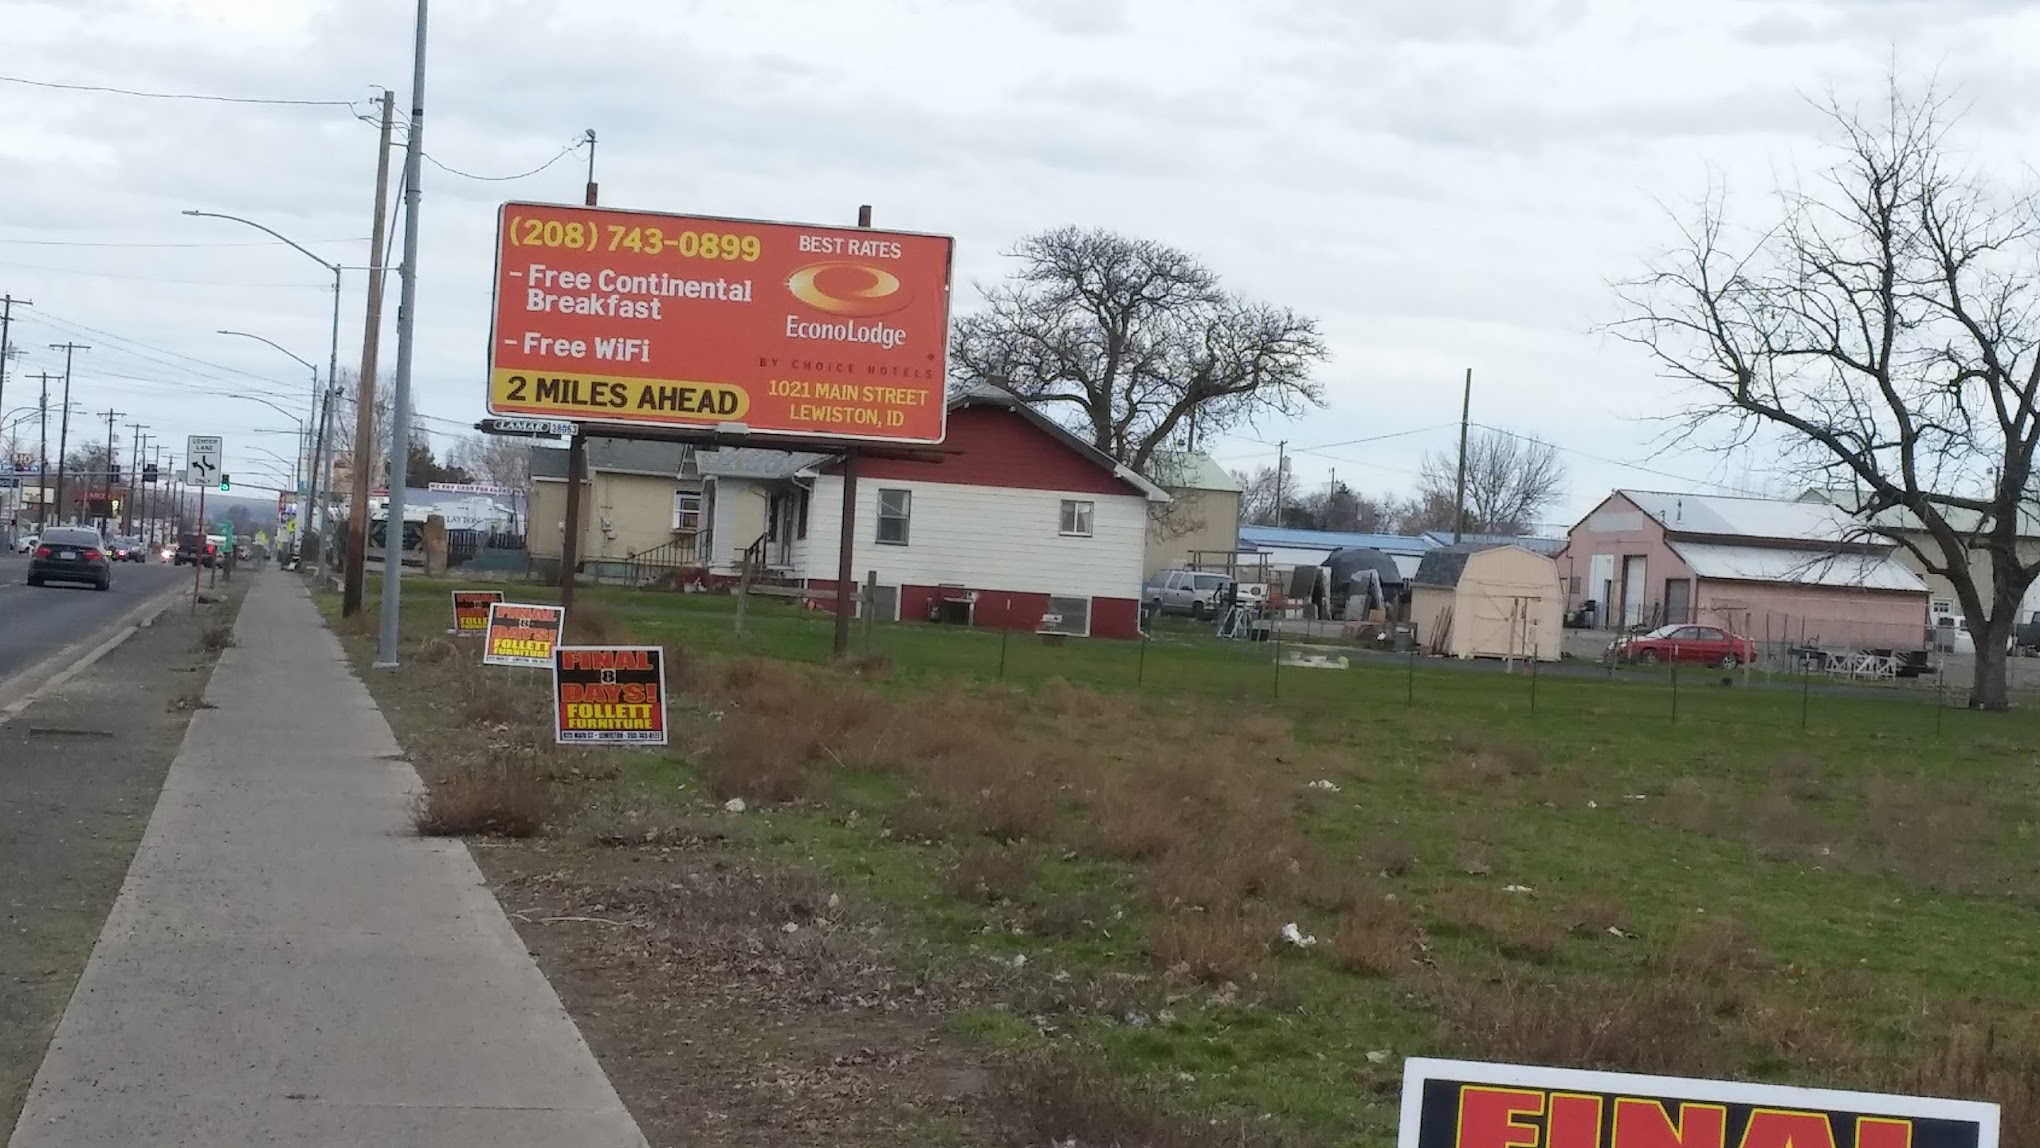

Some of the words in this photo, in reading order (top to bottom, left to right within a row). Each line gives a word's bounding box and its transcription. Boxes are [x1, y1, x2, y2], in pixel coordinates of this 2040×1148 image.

[510, 216, 598, 251] (208)
[607, 224, 761, 262] 743-0899
[800, 235, 844, 254] BEST
[848, 239, 901, 259] RATES
[529, 263, 591, 290] Free
[599, 268, 752, 302] Continental
[526, 289, 662, 319] Breakfast
[786, 315, 906, 349] EconoLodge
[524, 332, 586, 357] Free
[595, 337, 650, 362] WiFi
[760, 357, 778, 368] BY
[792, 359, 854, 373] CHOICE
[868, 365, 933, 379] HOTELS
[507, 376, 527, 402] 2
[535, 378, 628, 408] MILES
[637, 385, 738, 415] AHEAD
[769, 379, 811, 398] 1021
[815, 383, 858, 401] MAIN
[863, 386, 929, 406] STREET
[501, 421, 542, 431] LAMAR
[790, 403, 882, 428] LEWISTON,
[887, 411, 904, 426] ID
[496, 606, 556, 621] FINAL
[493, 638, 551, 652] FOLLETT
[562, 651, 654, 671] FINAL
[561, 683, 658, 703] DAYS!
[566, 703, 653, 719] FOLLETT
[568, 718, 653, 730] FURNITURE
